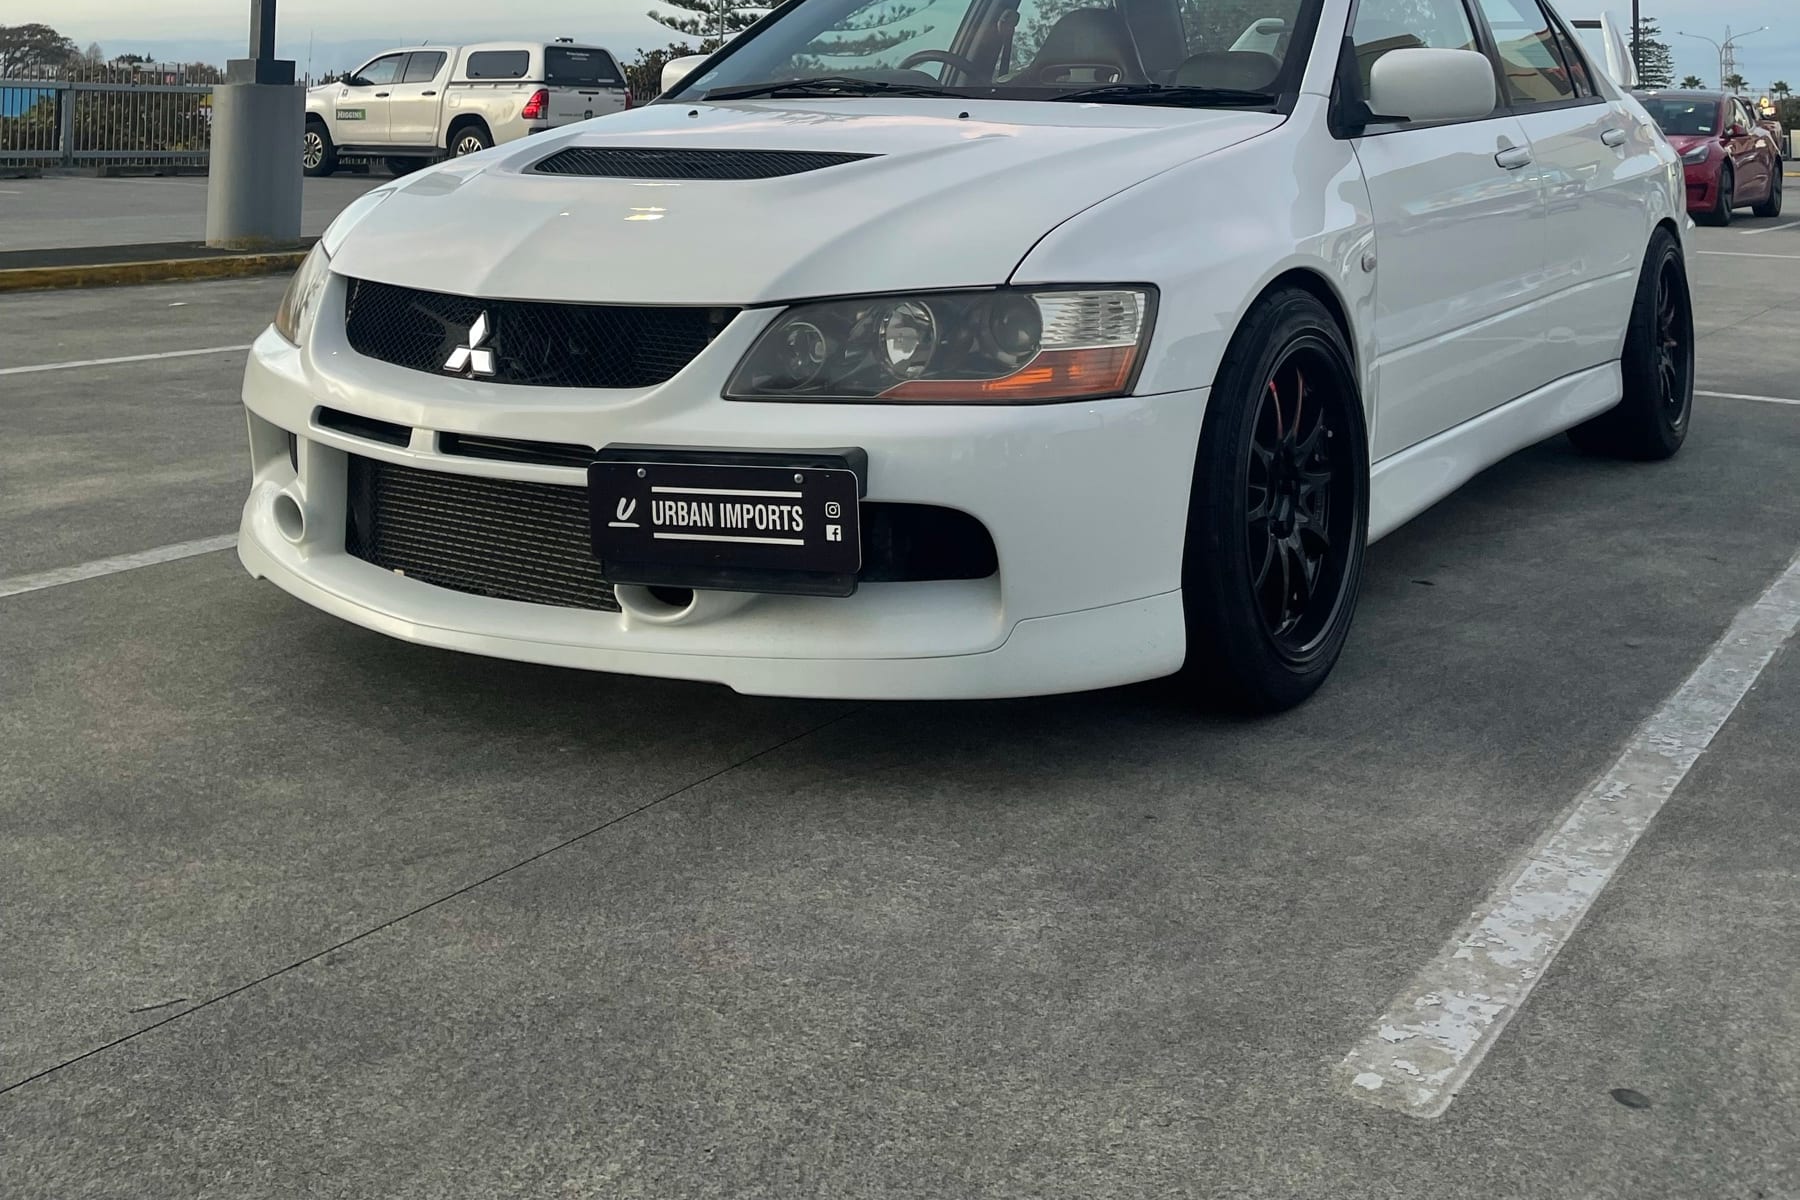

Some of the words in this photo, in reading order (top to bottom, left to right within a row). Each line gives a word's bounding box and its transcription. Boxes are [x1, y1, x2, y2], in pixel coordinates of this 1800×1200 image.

[337, 110, 362, 119] HIGGINS
[652, 500, 714, 528] URBAN
[719, 503, 804, 532] IMPORTS
